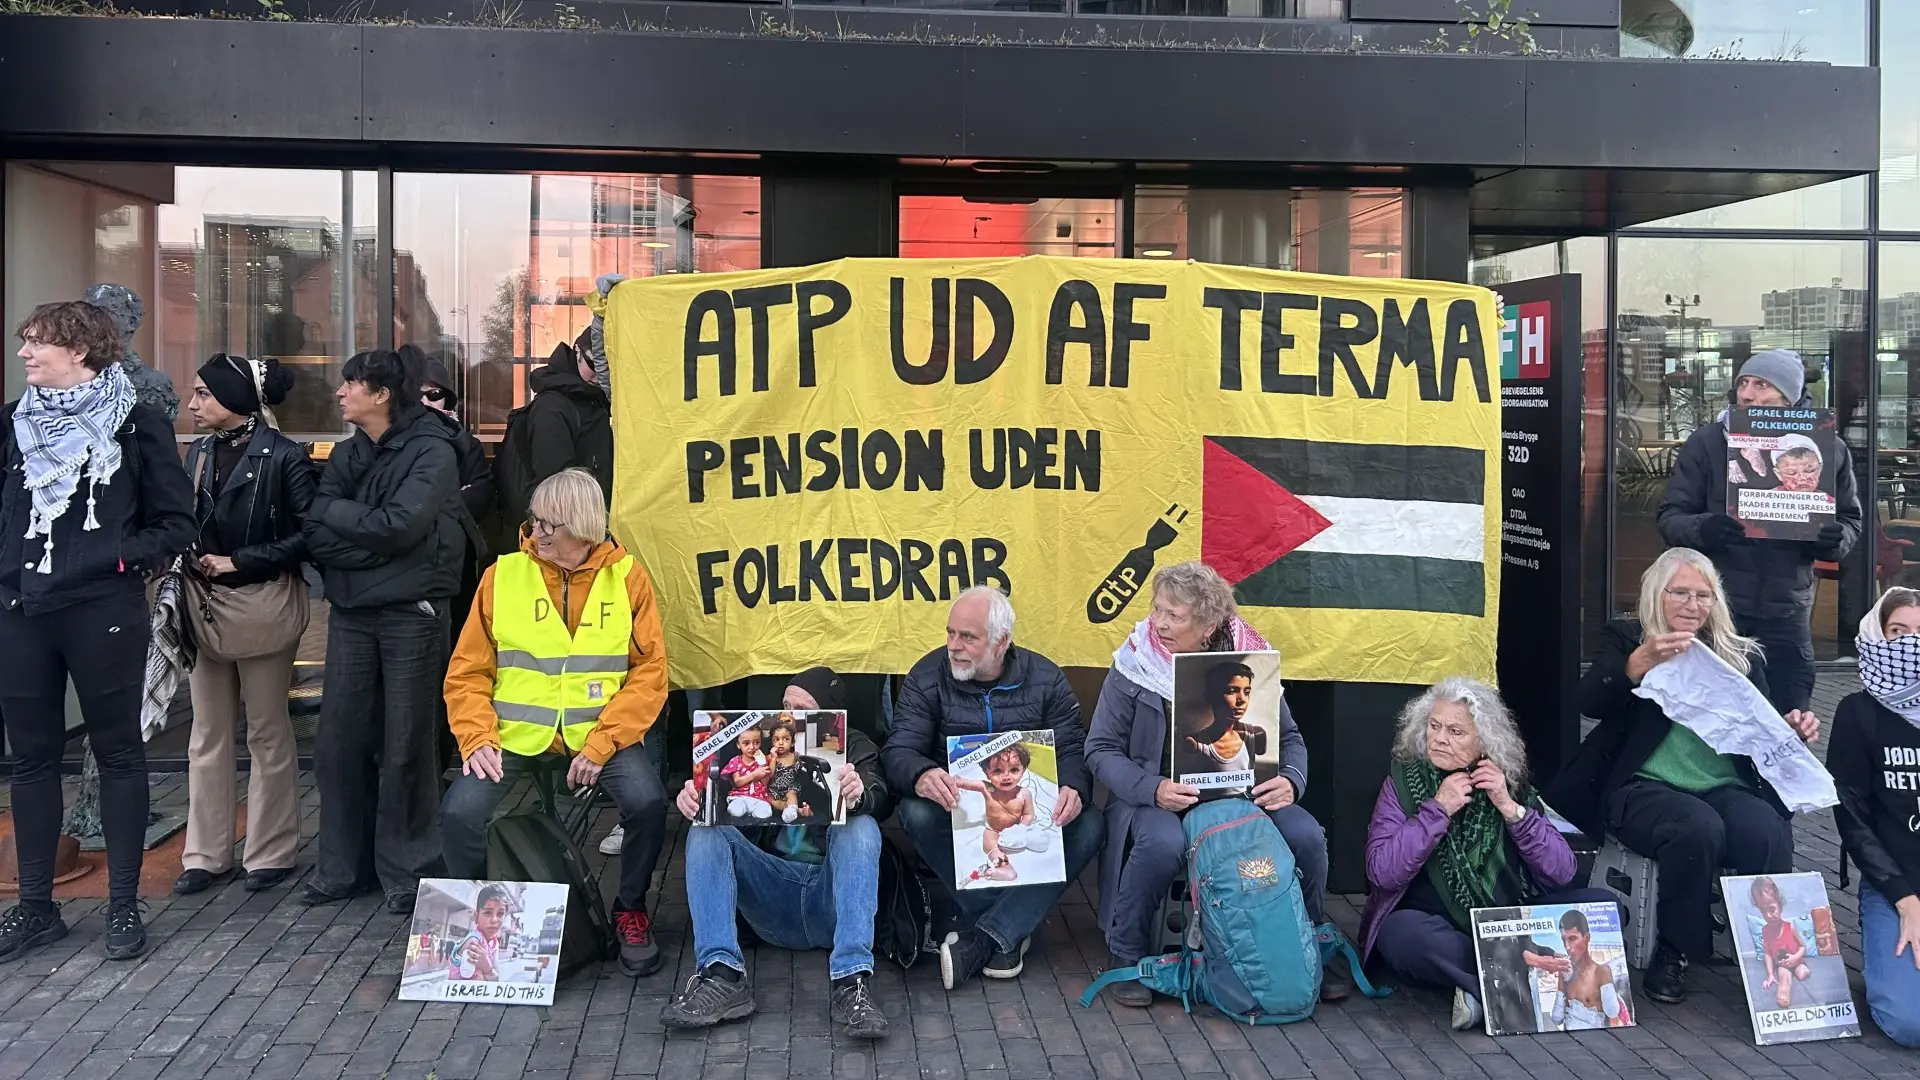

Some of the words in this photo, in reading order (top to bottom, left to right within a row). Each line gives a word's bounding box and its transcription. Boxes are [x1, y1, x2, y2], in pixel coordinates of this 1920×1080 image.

[684, 279, 852, 401] ATP
[890, 277, 1014, 385] UD
[1045, 280, 1167, 388] AF
[1203, 287, 1491, 403] TERMA
[1499, 315, 1544, 365] FH
[1748, 409, 1781, 418] ISRAEL
[1783, 408, 1817, 419] BEGÅR
[1751, 421, 1814, 431] FOLKEMORD
[1519, 431, 1539, 442] Brygge
[1508, 445, 1530, 463] 32D
[686, 427, 944, 503] PENSION
[969, 427, 1101, 492] UDEN
[1512, 488, 1526, 499] OAO
[1739, 490, 1811, 501] FORBRÆNDINGER
[1739, 501, 1770, 509] SKADER
[1772, 502, 1796, 510] EFTER
[1797, 504, 1835, 512] ISRAELSK
[1510, 508, 1527, 521] DTDA
[1739, 511, 1809, 520] BOMBARDEMENT
[1527, 559, 1540, 570] A/S
[697, 538, 1011, 615] FOLKEDRAB
[1096, 567, 1138, 615] atp
[694, 737, 724, 759] ISRAEL
[724, 711, 759, 738] BOMBER
[956, 751, 985, 770] ISRAEL
[985, 732, 1020, 755] BOMBER
[1183, 776, 1212, 785] ISRAEL
[1215, 773, 1251, 783] BOMBER
[1883, 770, 1920, 790] RET
[1482, 924, 1514, 935] ISRAEL
[1516, 921, 1554, 932] BOMBER
[445, 984, 490, 998] ISRAEL
[1761, 1010, 1804, 1028] ISRAEL
